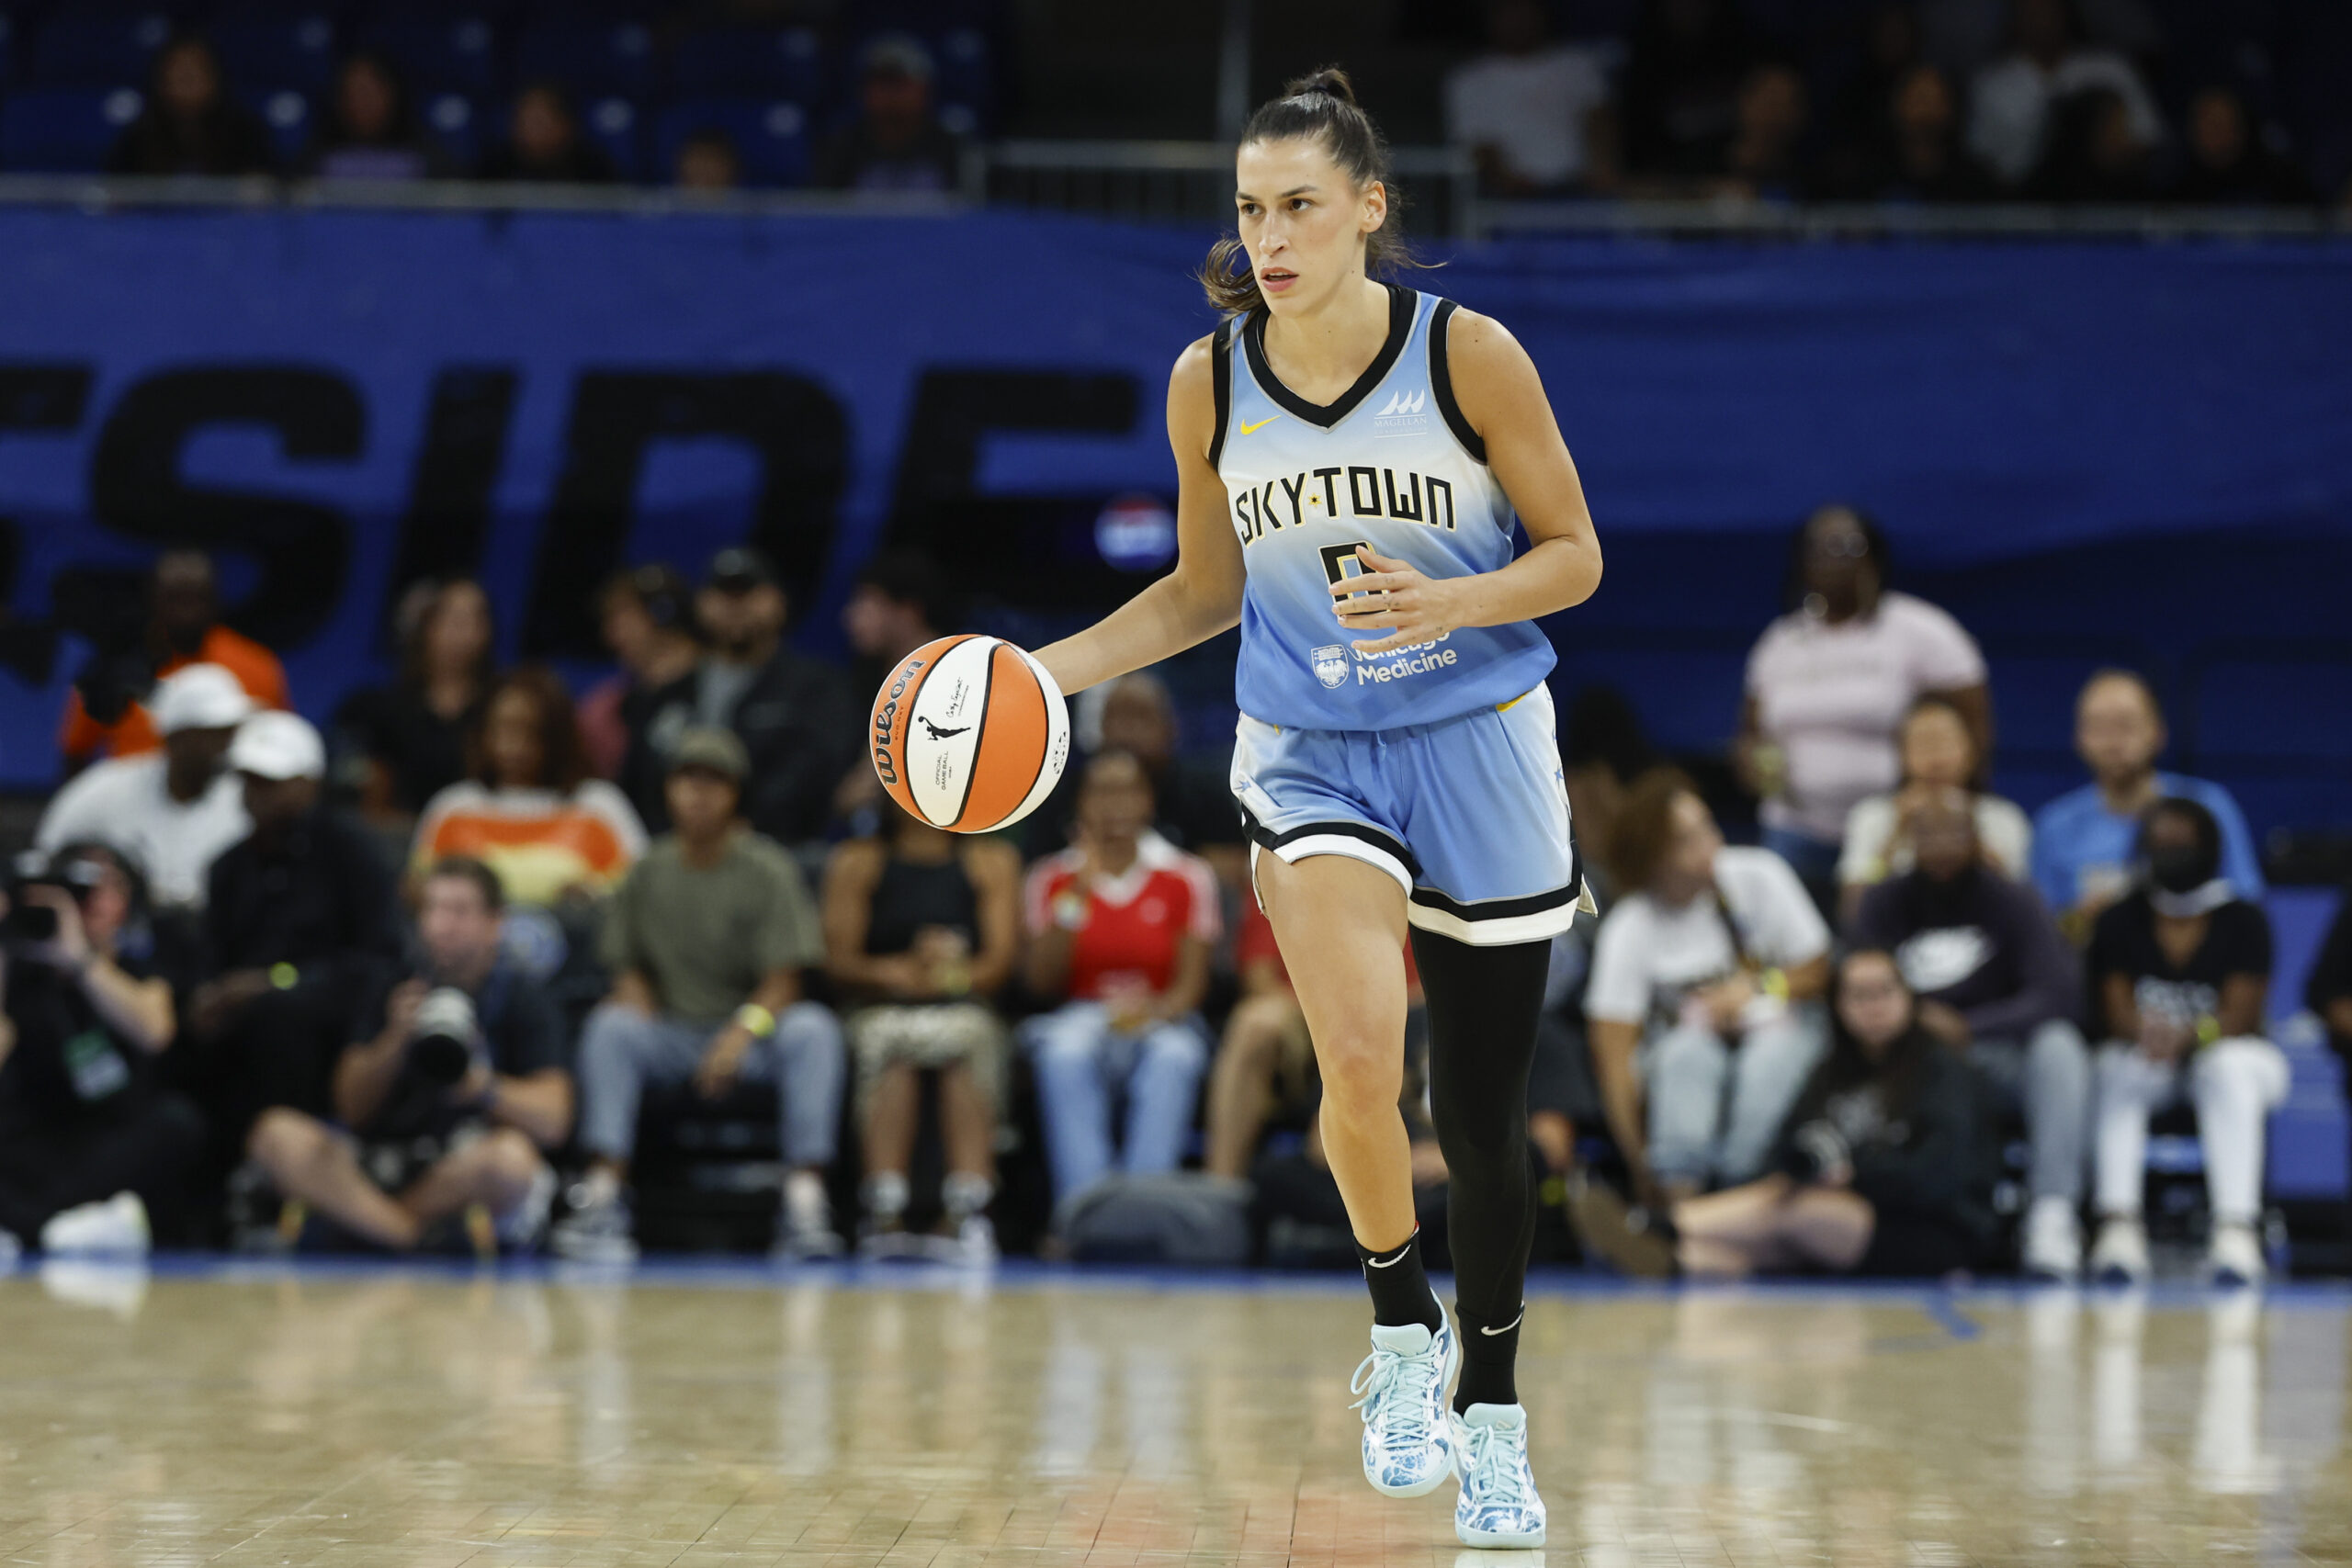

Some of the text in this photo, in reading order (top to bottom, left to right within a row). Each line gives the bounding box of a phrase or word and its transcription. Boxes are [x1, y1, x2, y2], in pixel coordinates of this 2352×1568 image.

[1374, 417, 1427, 427] MAGELLAN
[1356, 649, 1458, 685] Medicine
[876, 660, 926, 785] Wilson
